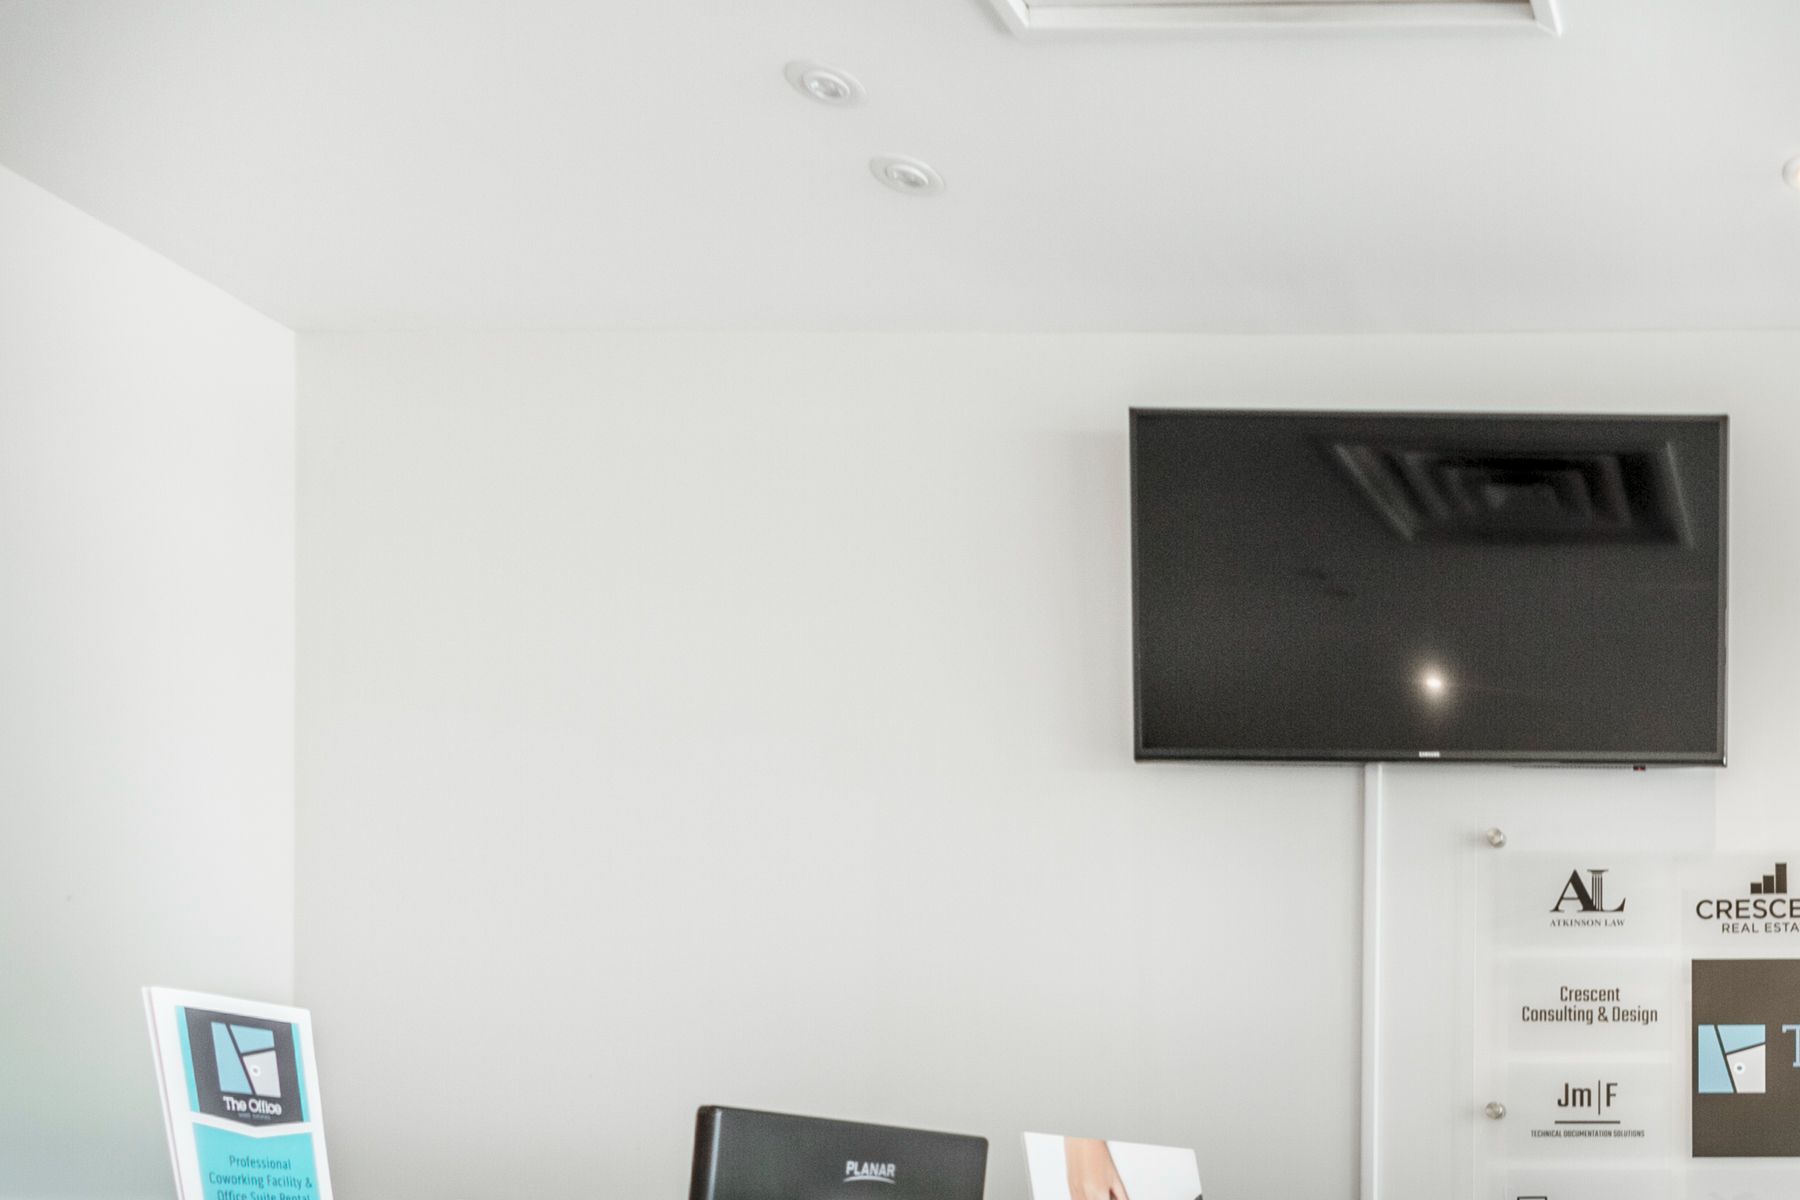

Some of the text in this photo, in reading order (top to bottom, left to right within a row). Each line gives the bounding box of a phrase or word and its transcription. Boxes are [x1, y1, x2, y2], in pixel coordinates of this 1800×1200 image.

[1550, 919, 1626, 927] ATKINSON LAW
[1722, 923, 1759, 934] REAL
[1560, 986, 1620, 1002] Crescent
[1522, 1006, 1658, 1025] Consulting & Design
[223, 1096, 246, 1112] The
[248, 1098, 282, 1116] Office
[1531, 1130, 1645, 1138] TECHNICAL DOCUMENTATION SOLUTIONS
[229, 1155, 291, 1169] Professional
[845, 1160, 896, 1178] PLANAR
[209, 1172, 264, 1189] Coworking
[267, 1175, 302, 1190] Facility
